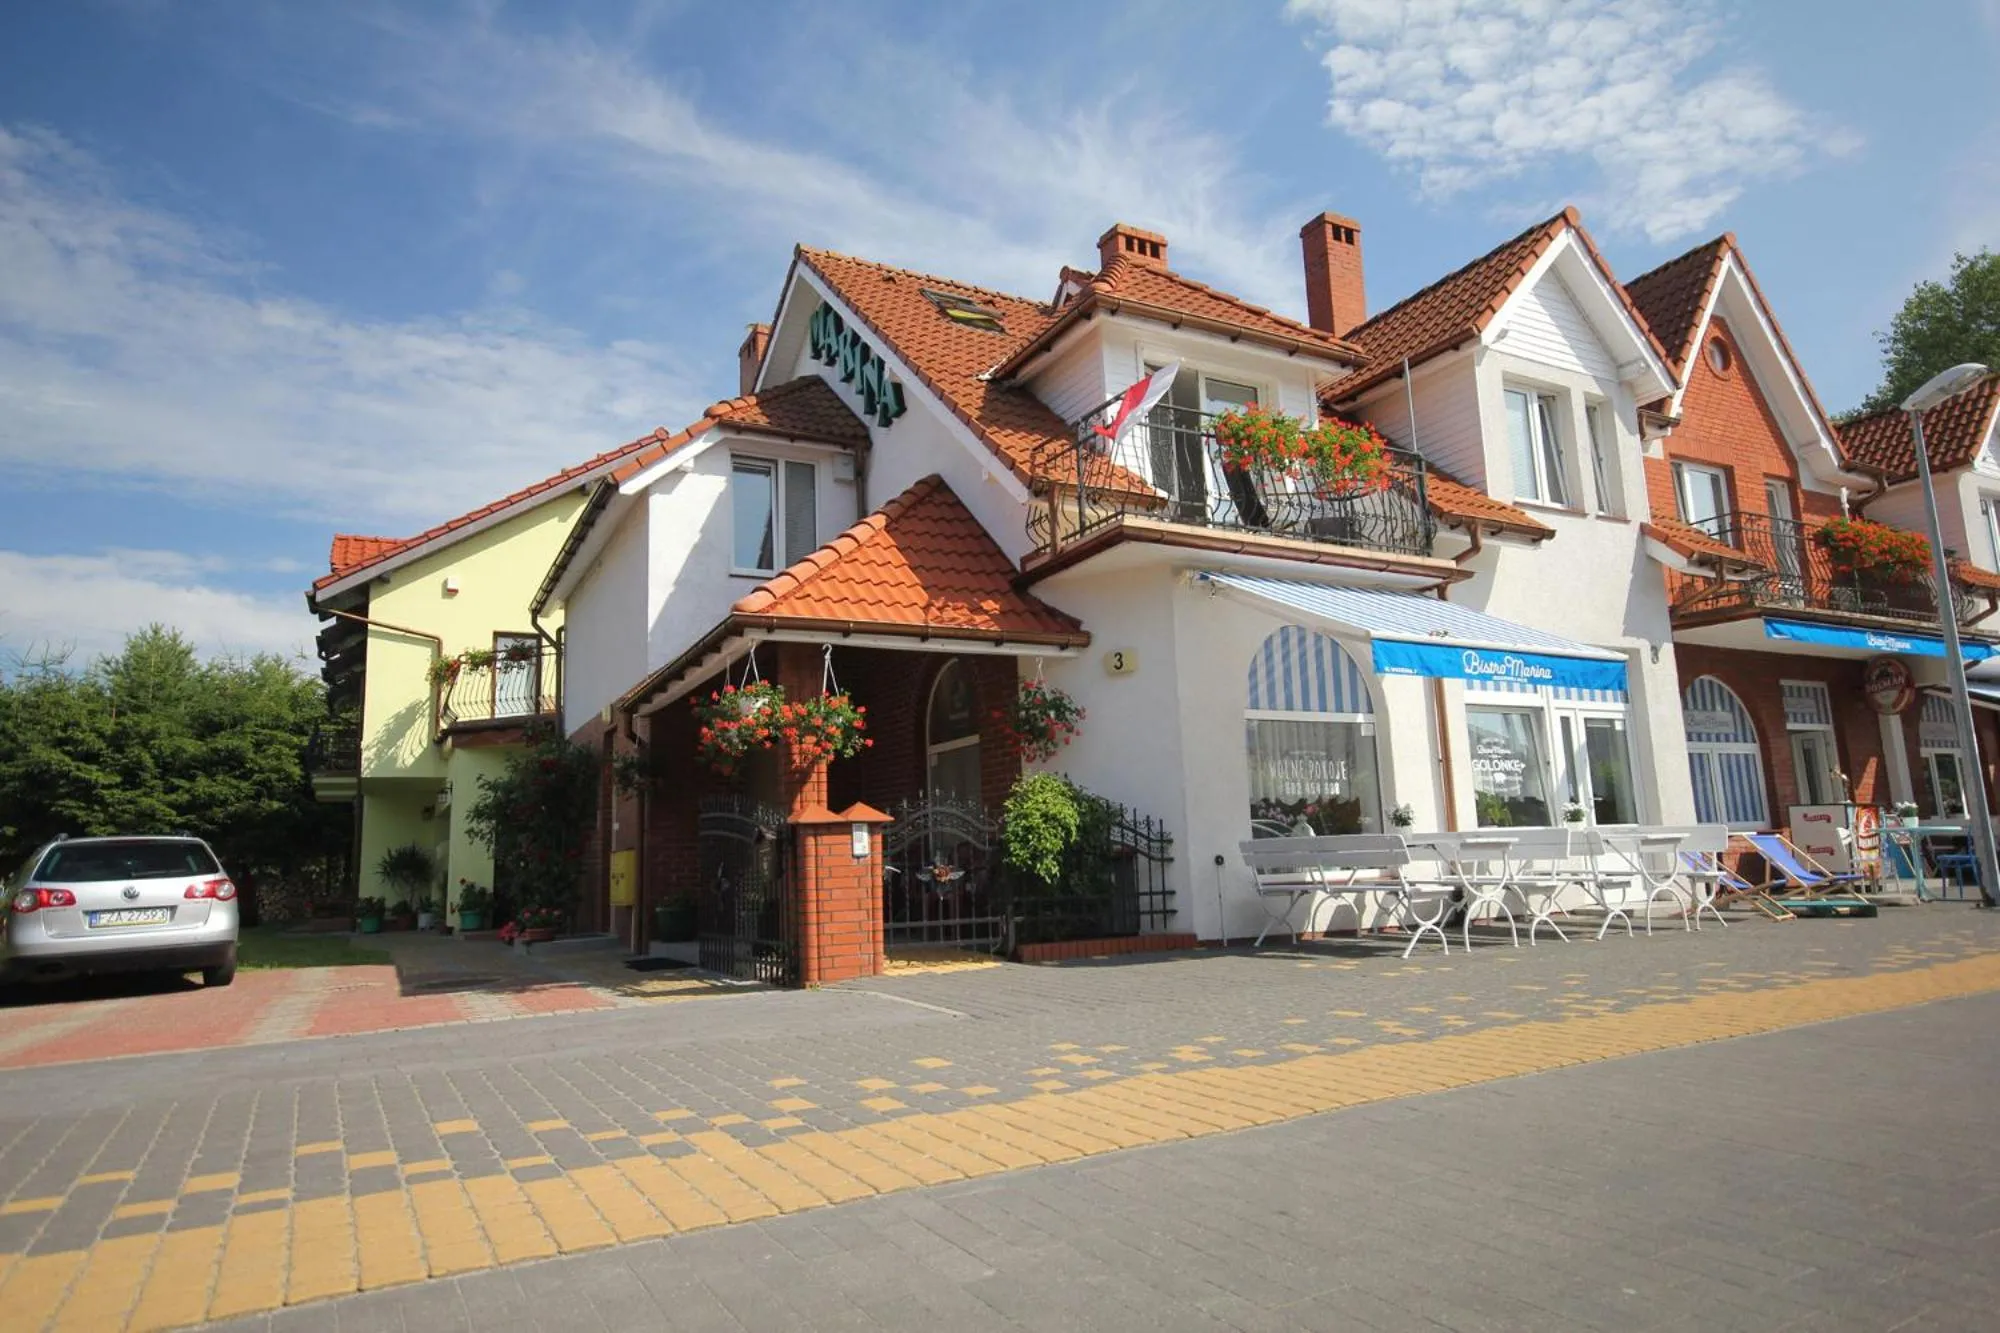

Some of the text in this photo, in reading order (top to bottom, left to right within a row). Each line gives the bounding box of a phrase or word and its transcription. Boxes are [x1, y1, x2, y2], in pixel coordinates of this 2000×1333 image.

[809, 300, 907, 428] MARINA
[1113, 651, 1124, 670] 3
[1463, 650, 1553, 679] Bistro Marina
